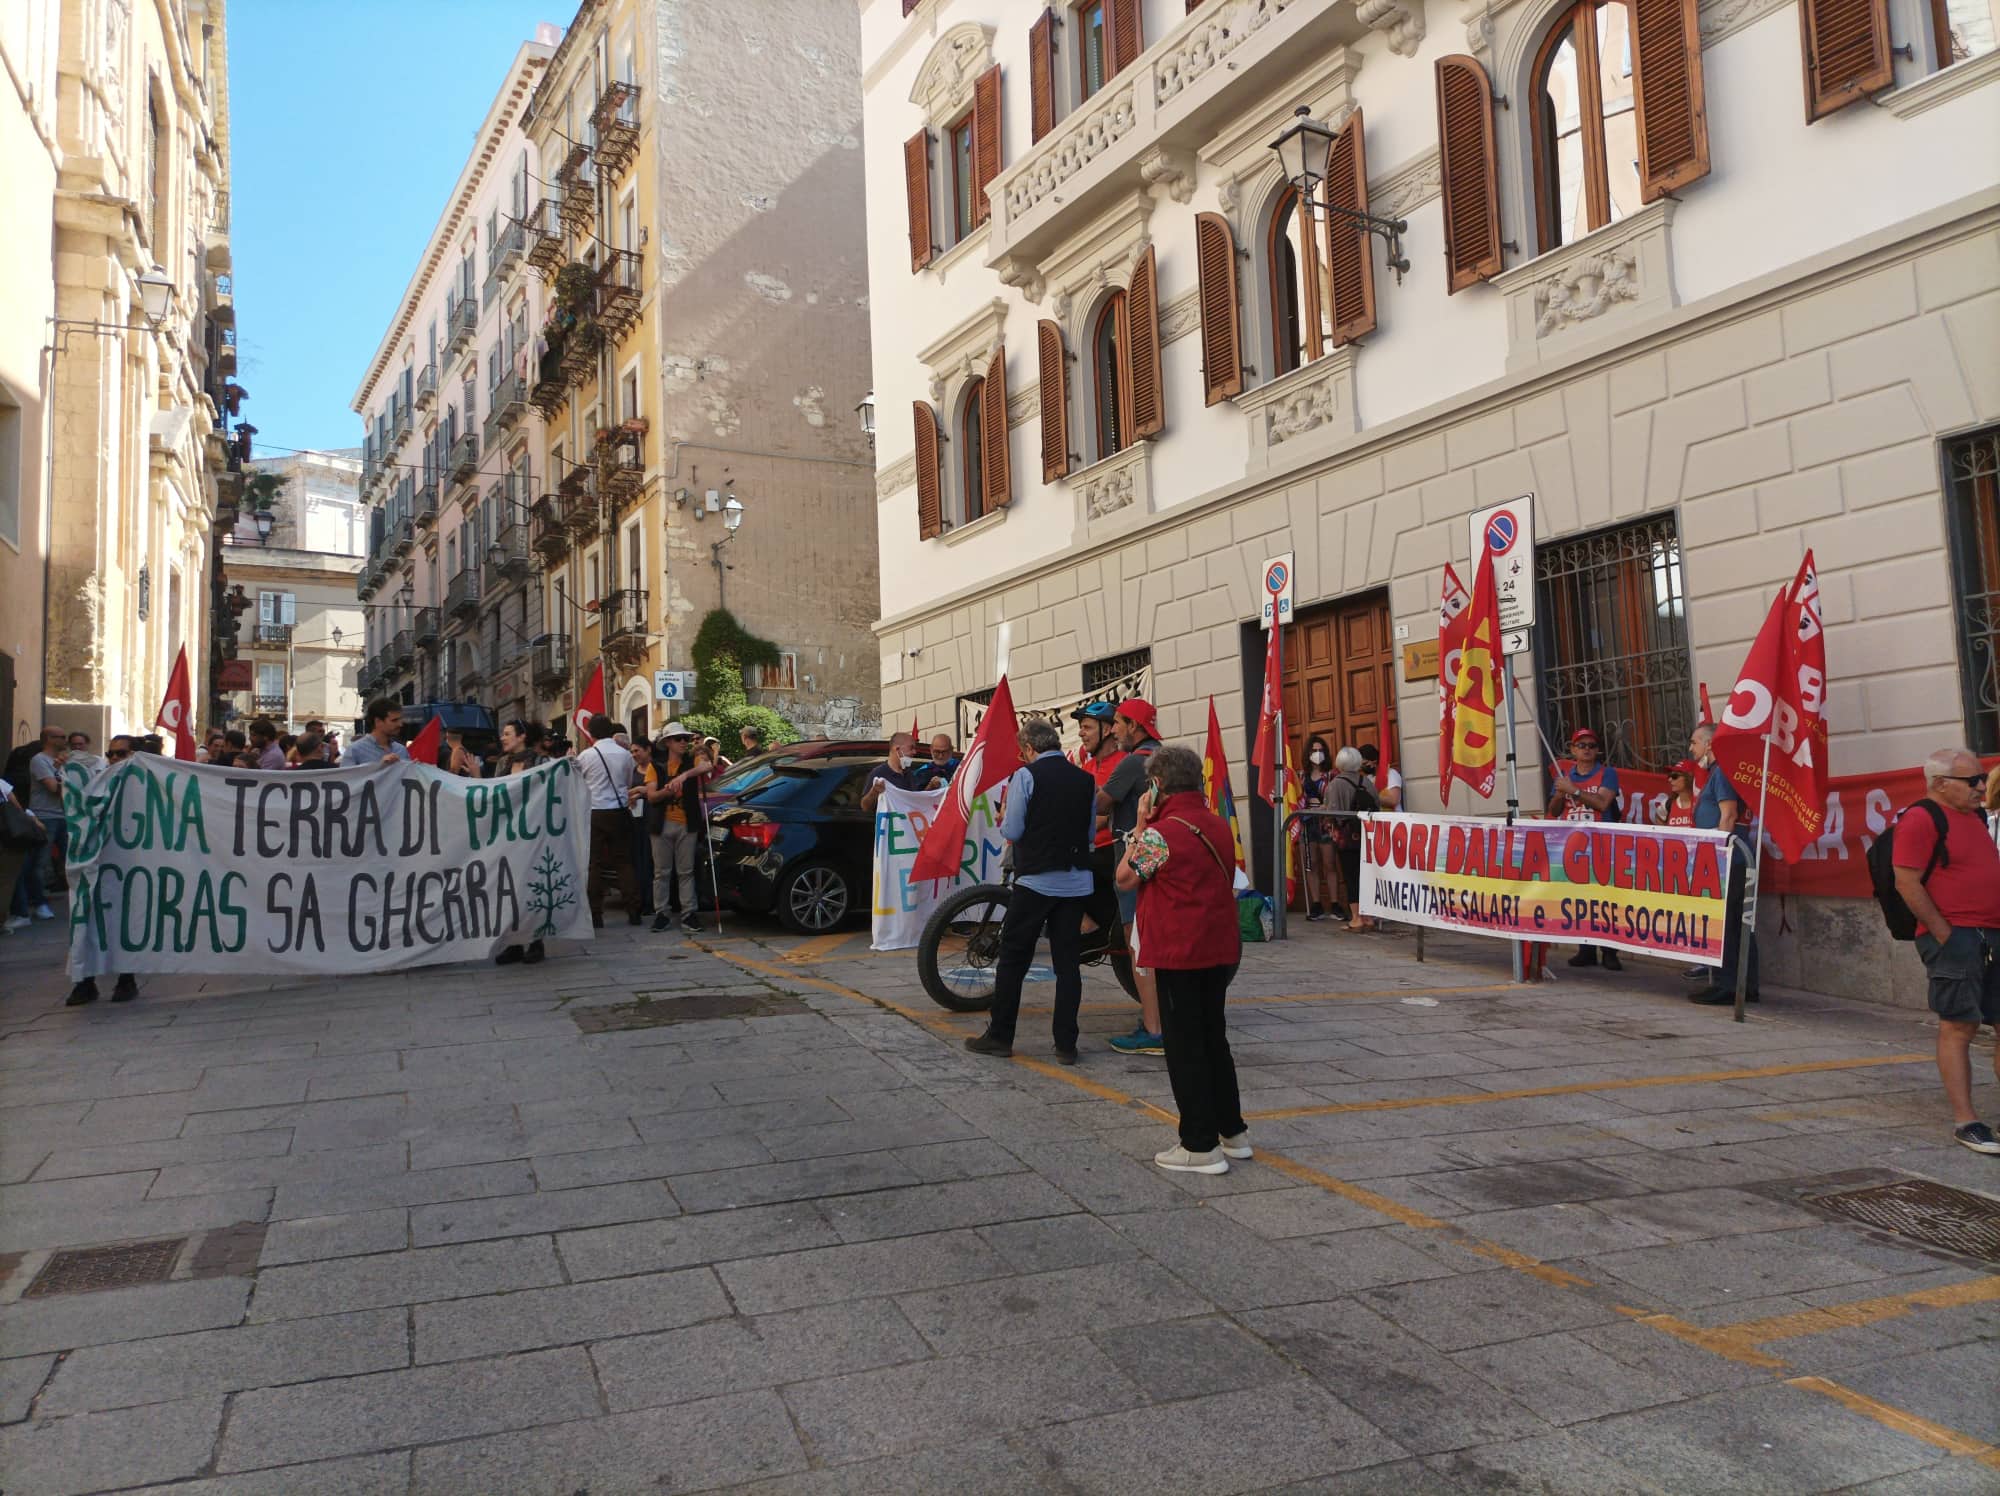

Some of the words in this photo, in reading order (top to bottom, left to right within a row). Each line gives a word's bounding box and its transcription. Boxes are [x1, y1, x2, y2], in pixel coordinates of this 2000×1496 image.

[1503, 579, 1515, 591] 24
[226, 778, 387, 858] TERRA
[400, 779, 442, 857] DI
[466, 758, 569, 851] PACE
[1362, 818, 1440, 873] FUORI
[1446, 824, 1551, 883] DALLA
[1562, 830, 1723, 900] GUERRA
[267, 872, 325, 954] SA
[348, 855, 520, 954] GHERRA
[1373, 877, 1457, 917] AUMENTARE
[1458, 889, 1520, 927] SALARI
[1533, 903, 1545, 929] e
[1560, 897, 1619, 935] SPESE
[1624, 908, 1710, 950] SOCIALI
